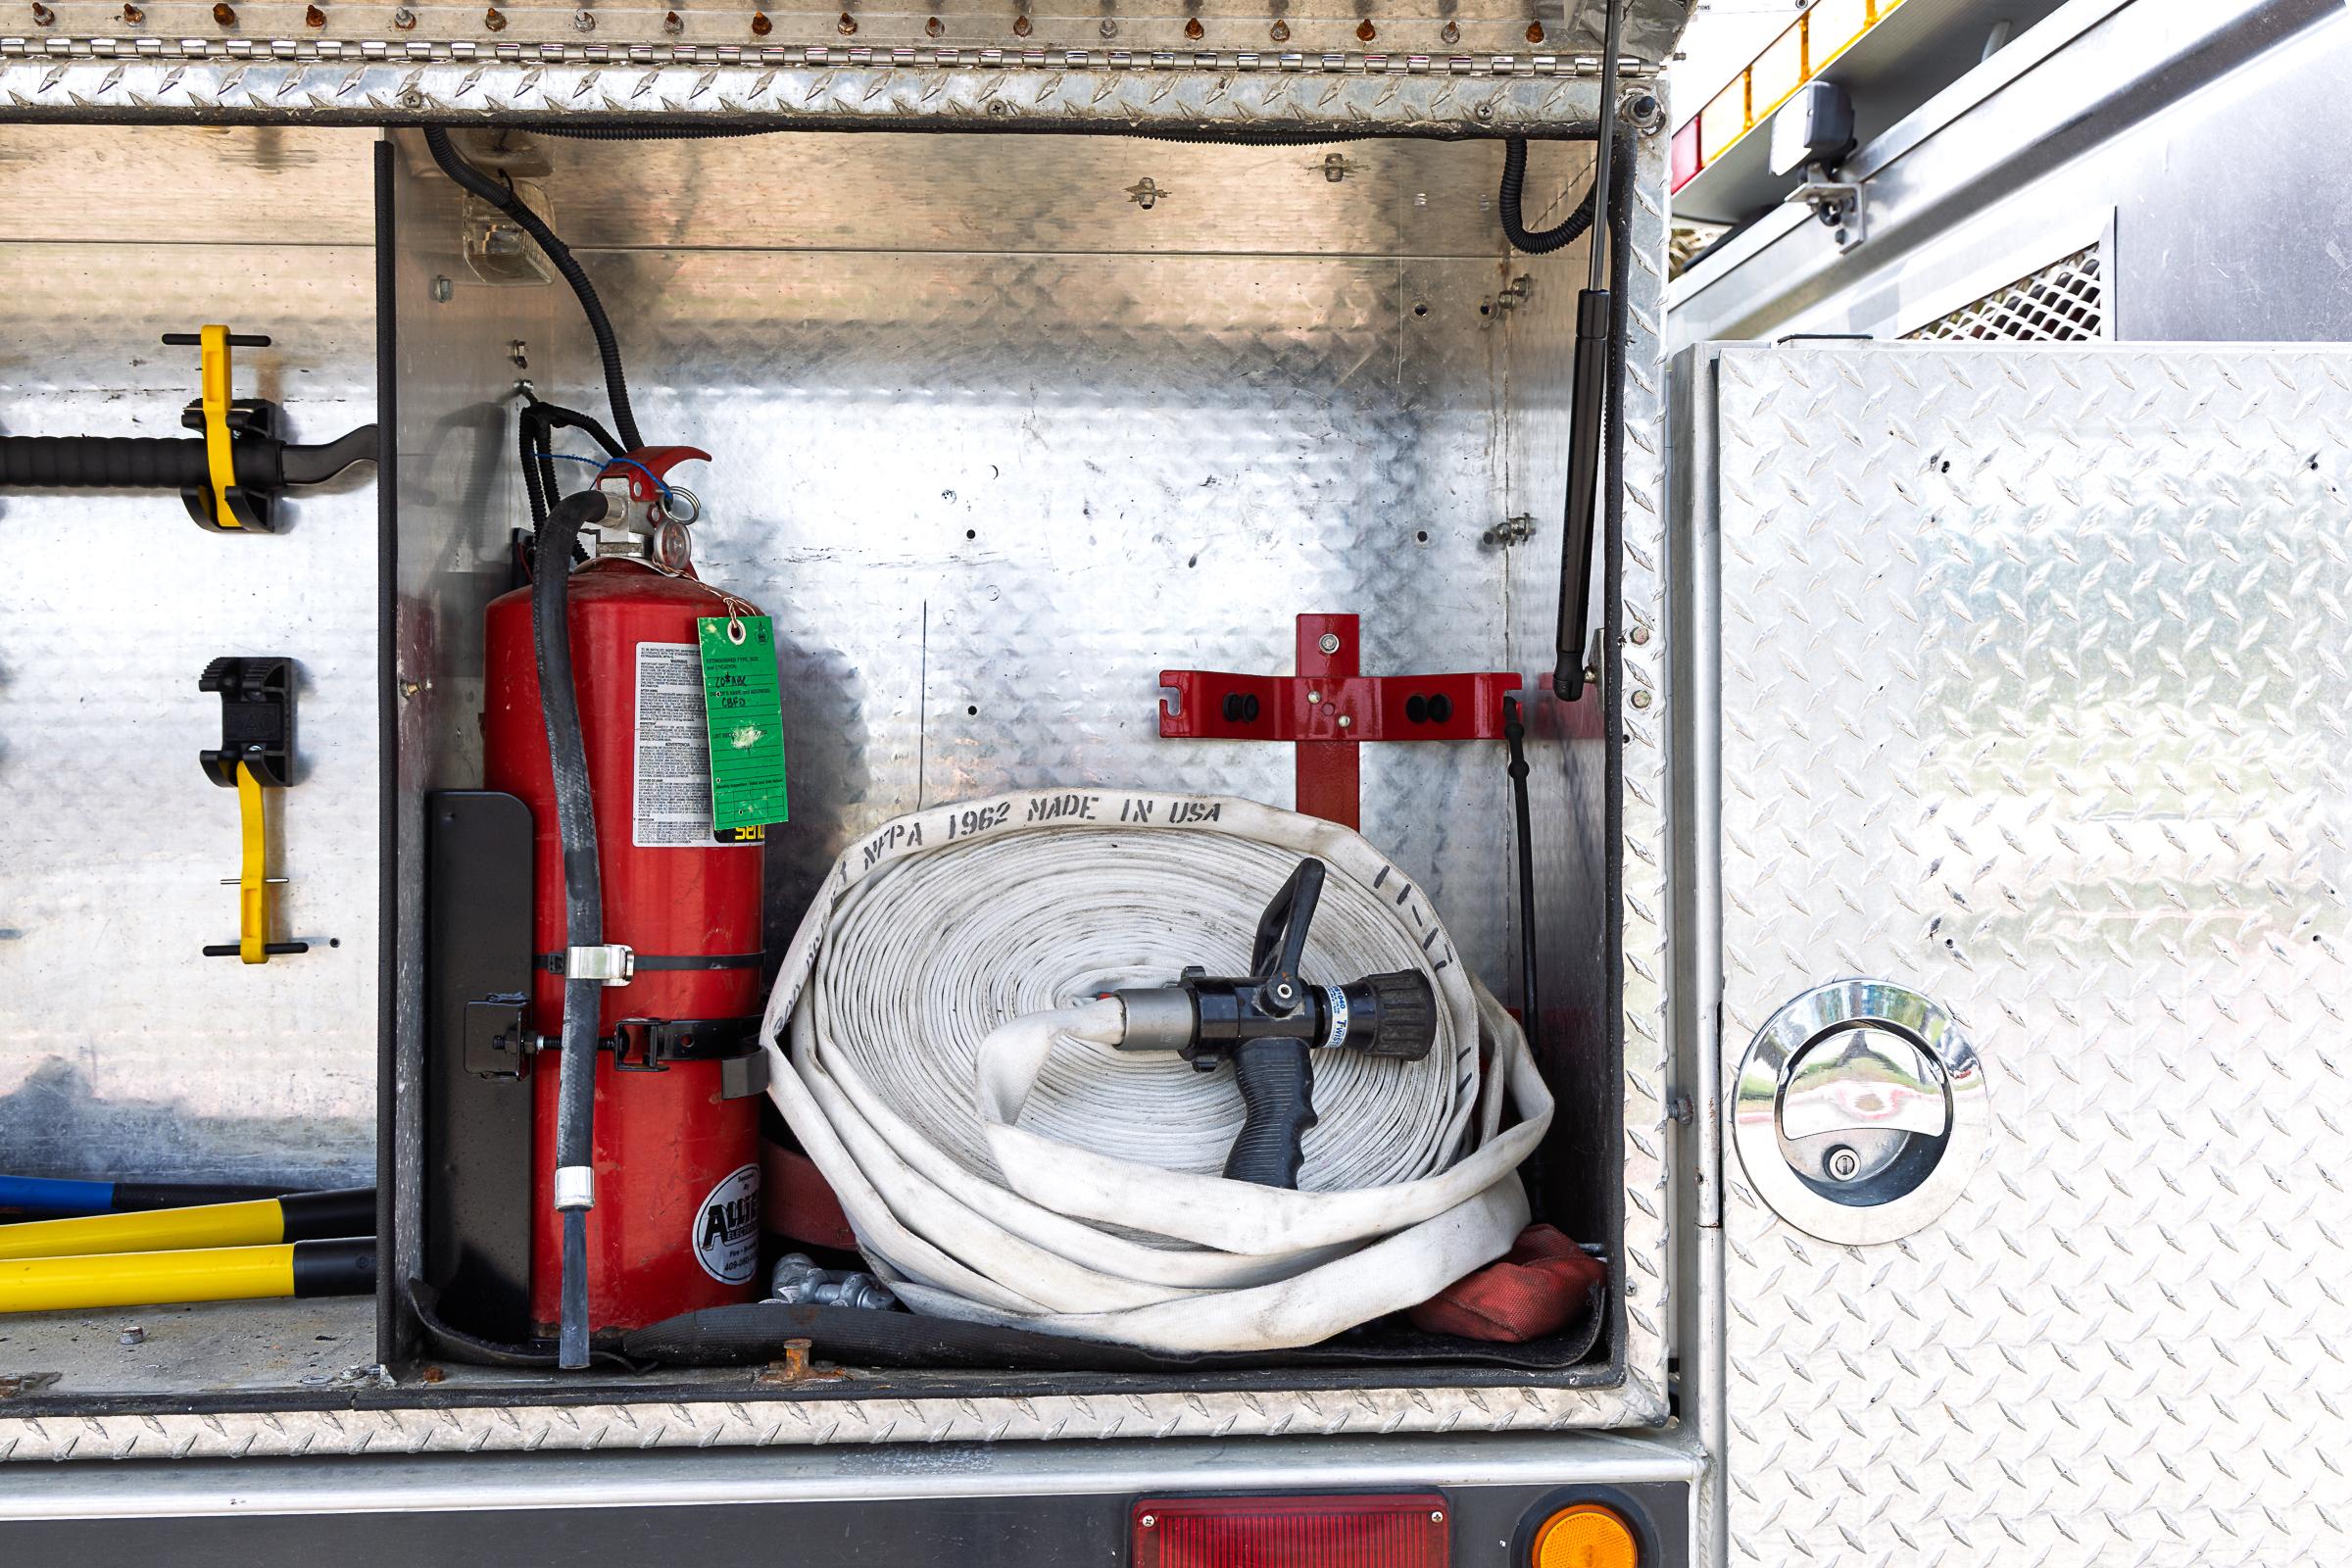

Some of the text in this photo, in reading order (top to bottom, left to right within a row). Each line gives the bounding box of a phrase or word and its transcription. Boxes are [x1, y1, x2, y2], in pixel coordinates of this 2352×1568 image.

[863, 795, 1222, 870] NFPA 1962 MADE IN USA
